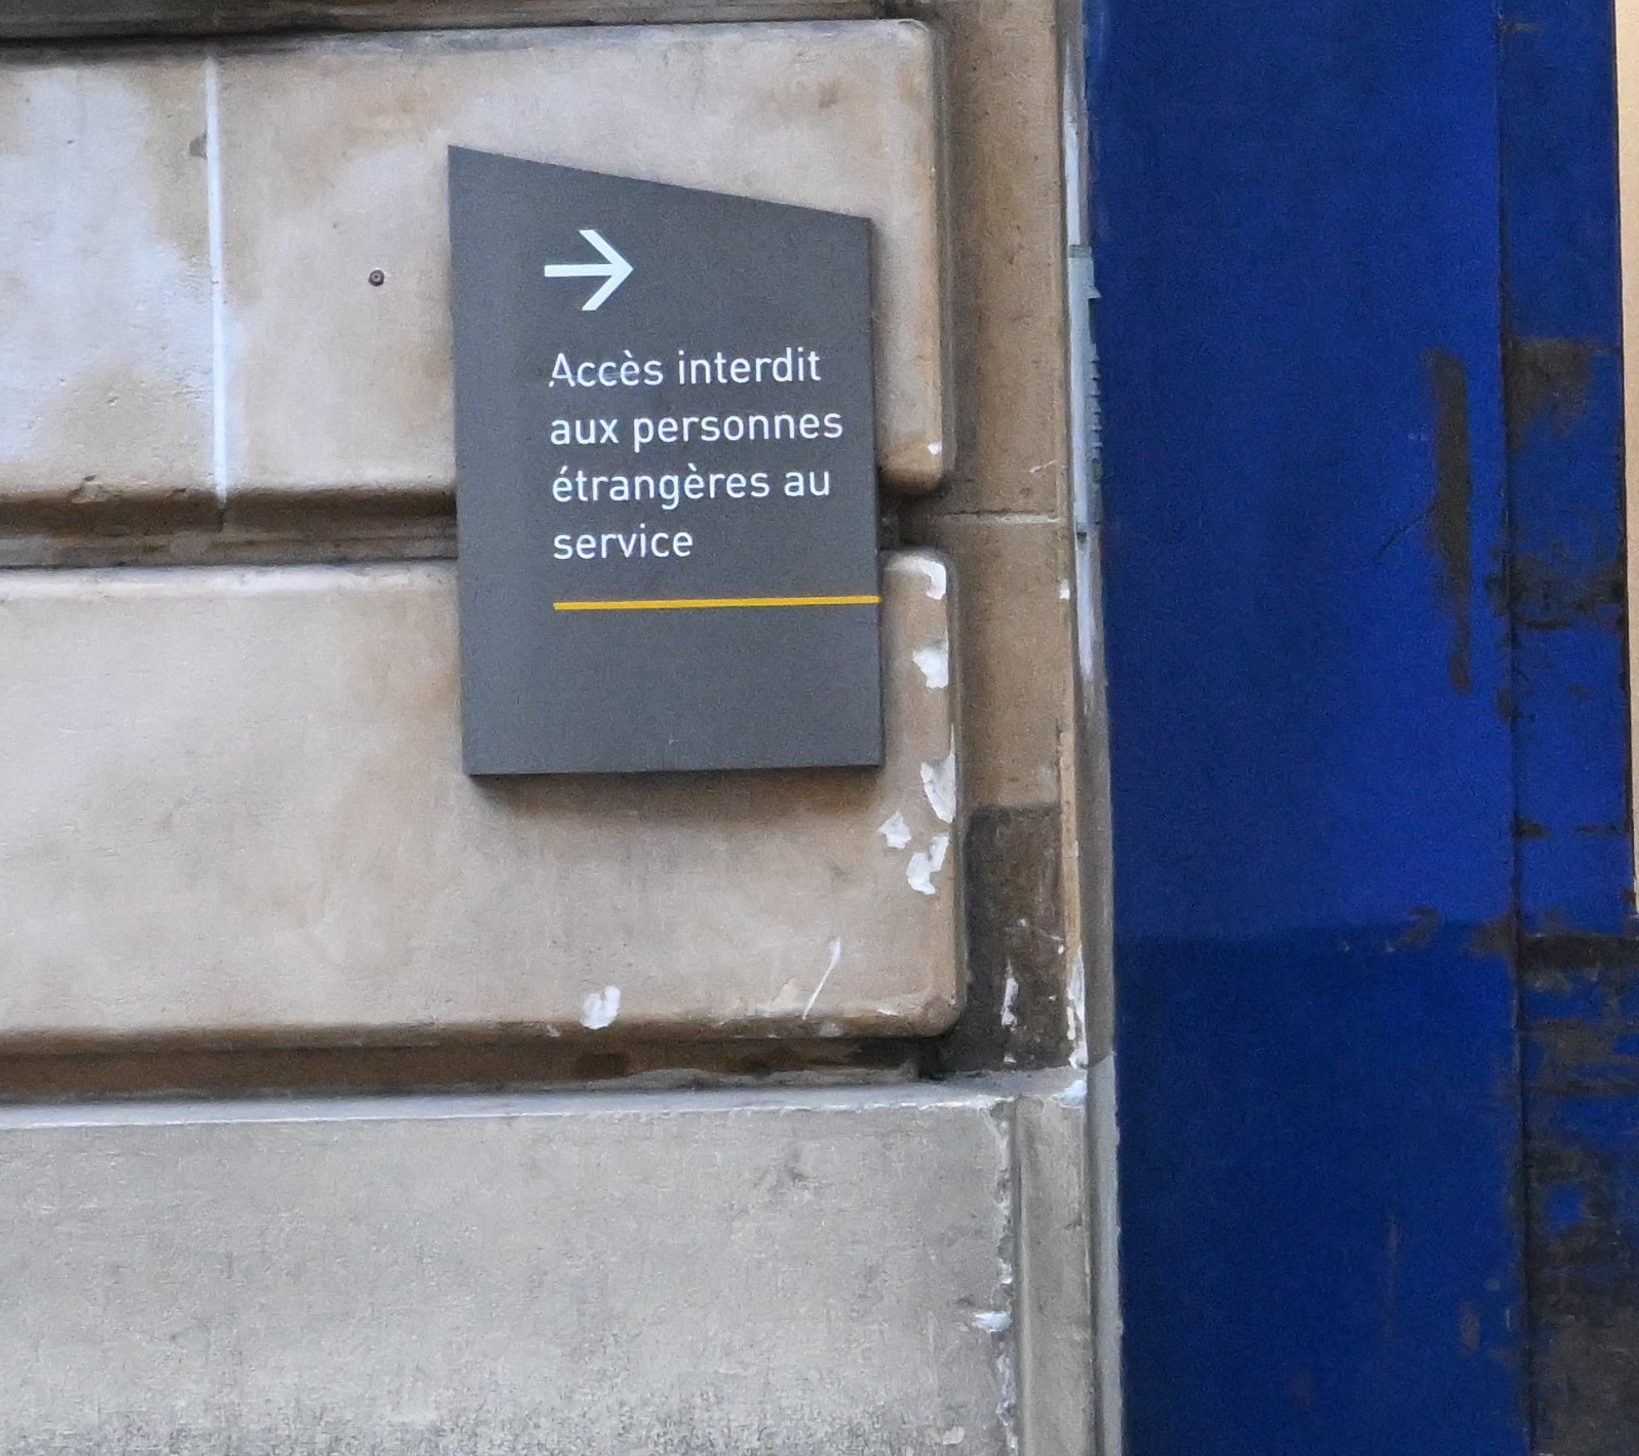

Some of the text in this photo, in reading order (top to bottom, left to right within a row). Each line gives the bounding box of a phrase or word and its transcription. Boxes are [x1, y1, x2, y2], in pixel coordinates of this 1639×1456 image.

[548, 346, 822, 387] Accès interdit
[550, 411, 843, 454] aux personnes
[551, 462, 831, 510] étrangères au
[553, 523, 694, 560] service
